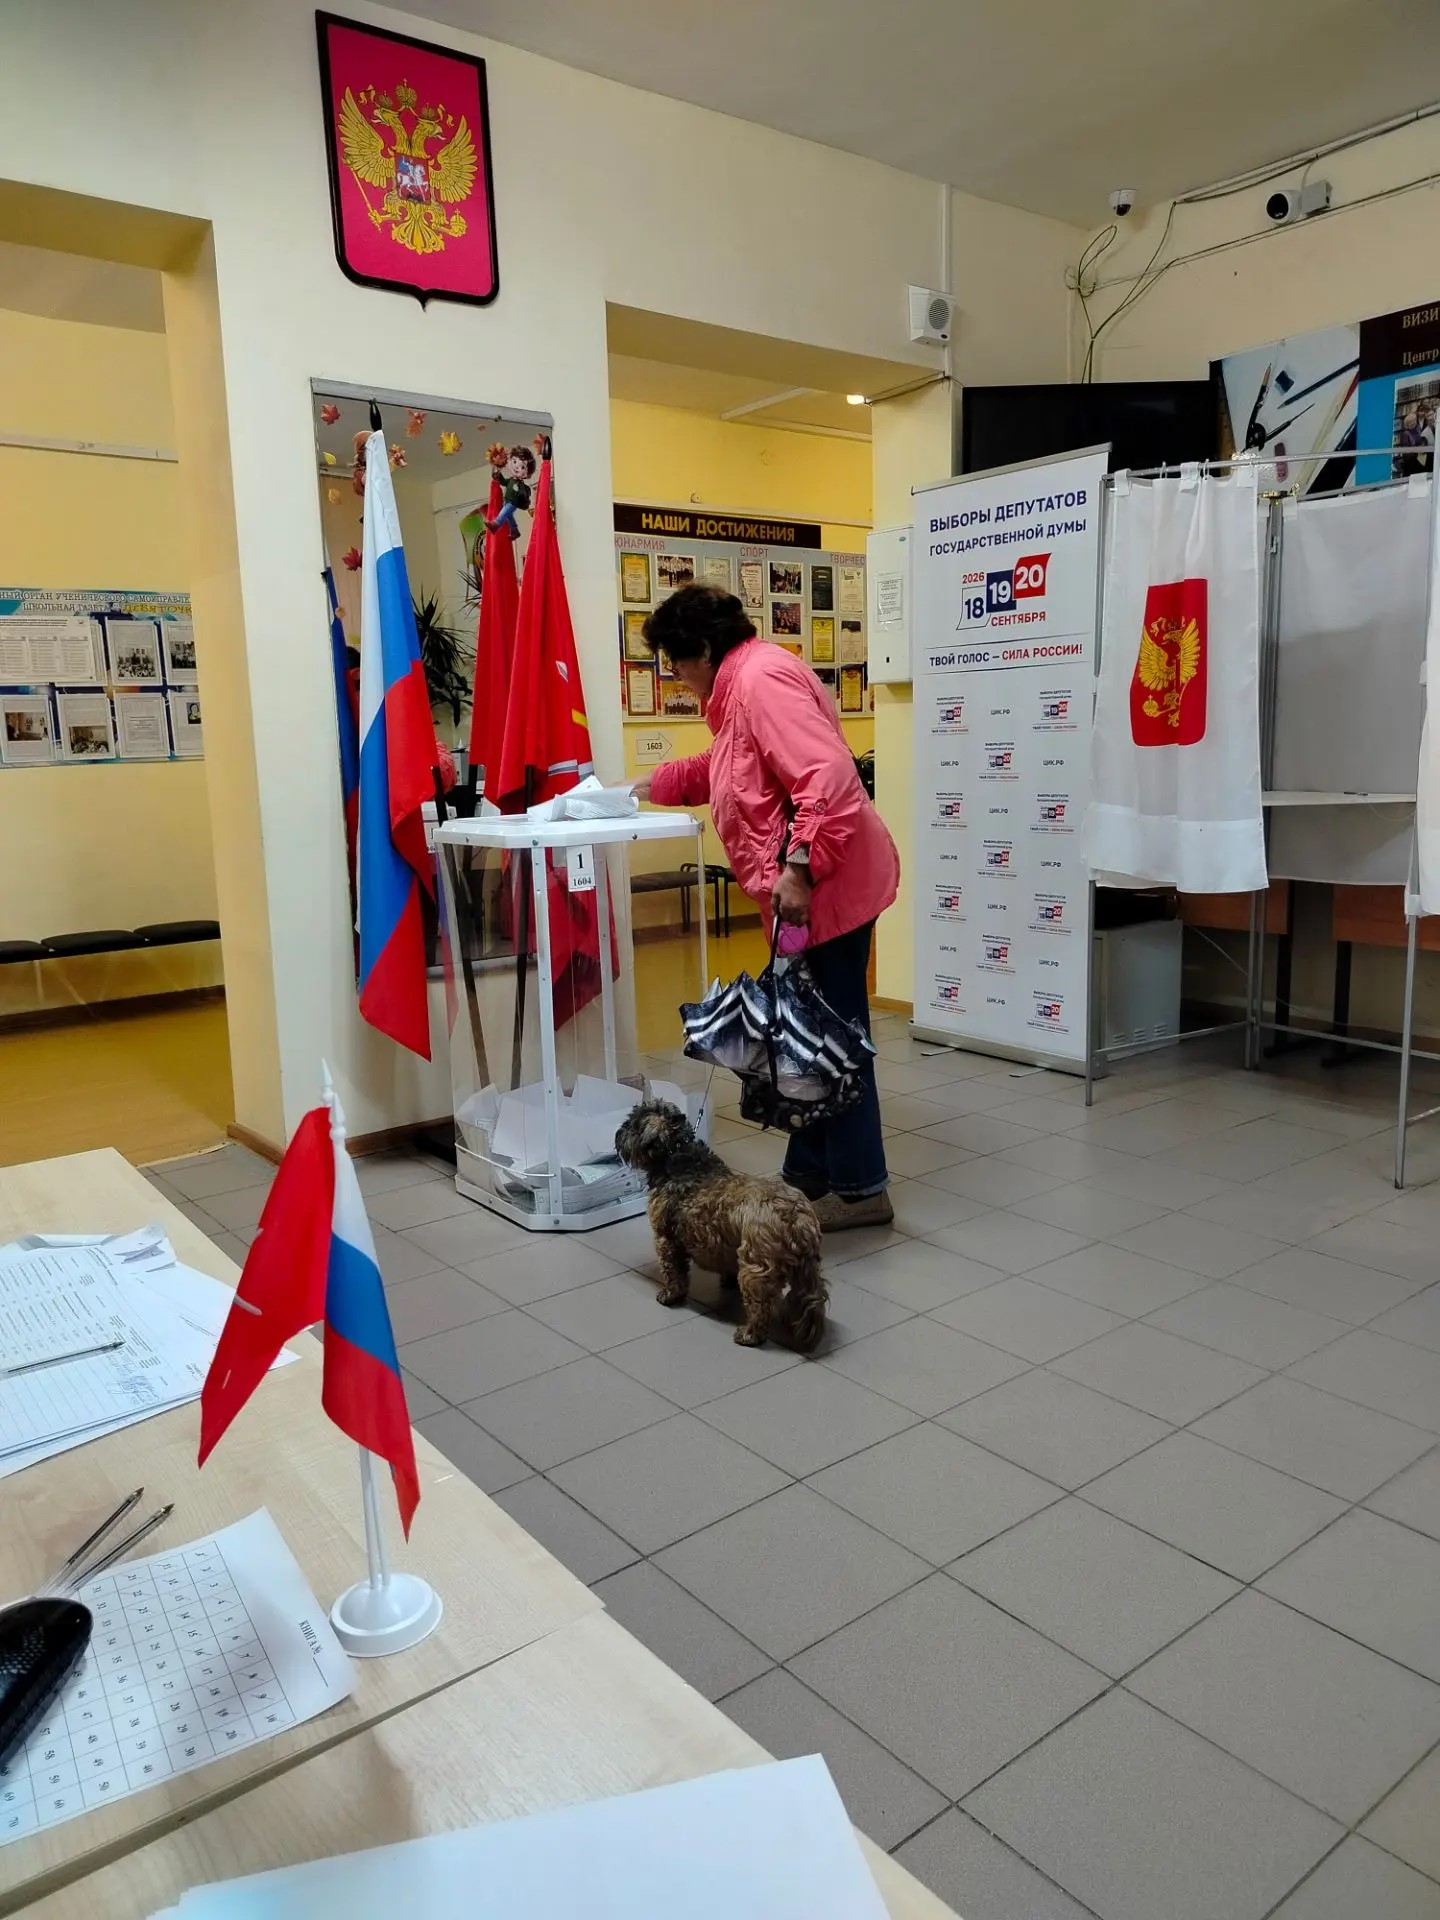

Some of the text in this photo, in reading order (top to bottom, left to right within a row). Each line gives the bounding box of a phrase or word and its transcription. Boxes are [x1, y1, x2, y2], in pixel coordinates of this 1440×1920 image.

[1402, 306, 1440, 328] ВИЗИ
[930, 490, 1087, 533] ВЫБОРЫ ДЕПУТАТОВ
[642, 513, 795, 542] НАШИ ДОСТИЖЕНИЯ
[615, 536, 665, 550] ЮНАРМИЯ
[930, 519, 1086, 556] ГОСУДАРСТВЕННОЙ ДУМЫ
[740, 547, 768, 558] СПОРТ
[962, 571, 985, 584] 2026
[964, 564, 1044, 620] 18 19 20
[991, 611, 1046, 627] СЕНТЯБРЯ
[929, 654, 955, 667] ТВОЙ
[957, 652, 990, 665] ГОЛОС
[1002, 648, 1030, 661] СИЛА
[1033, 643, 1083, 658] РОССИИ!
[646, 742, 663, 750] 1603
[577, 853, 583, 870] 1
[573, 876, 592, 887] 1604
[299, 1620, 317, 1647] КНИГА
